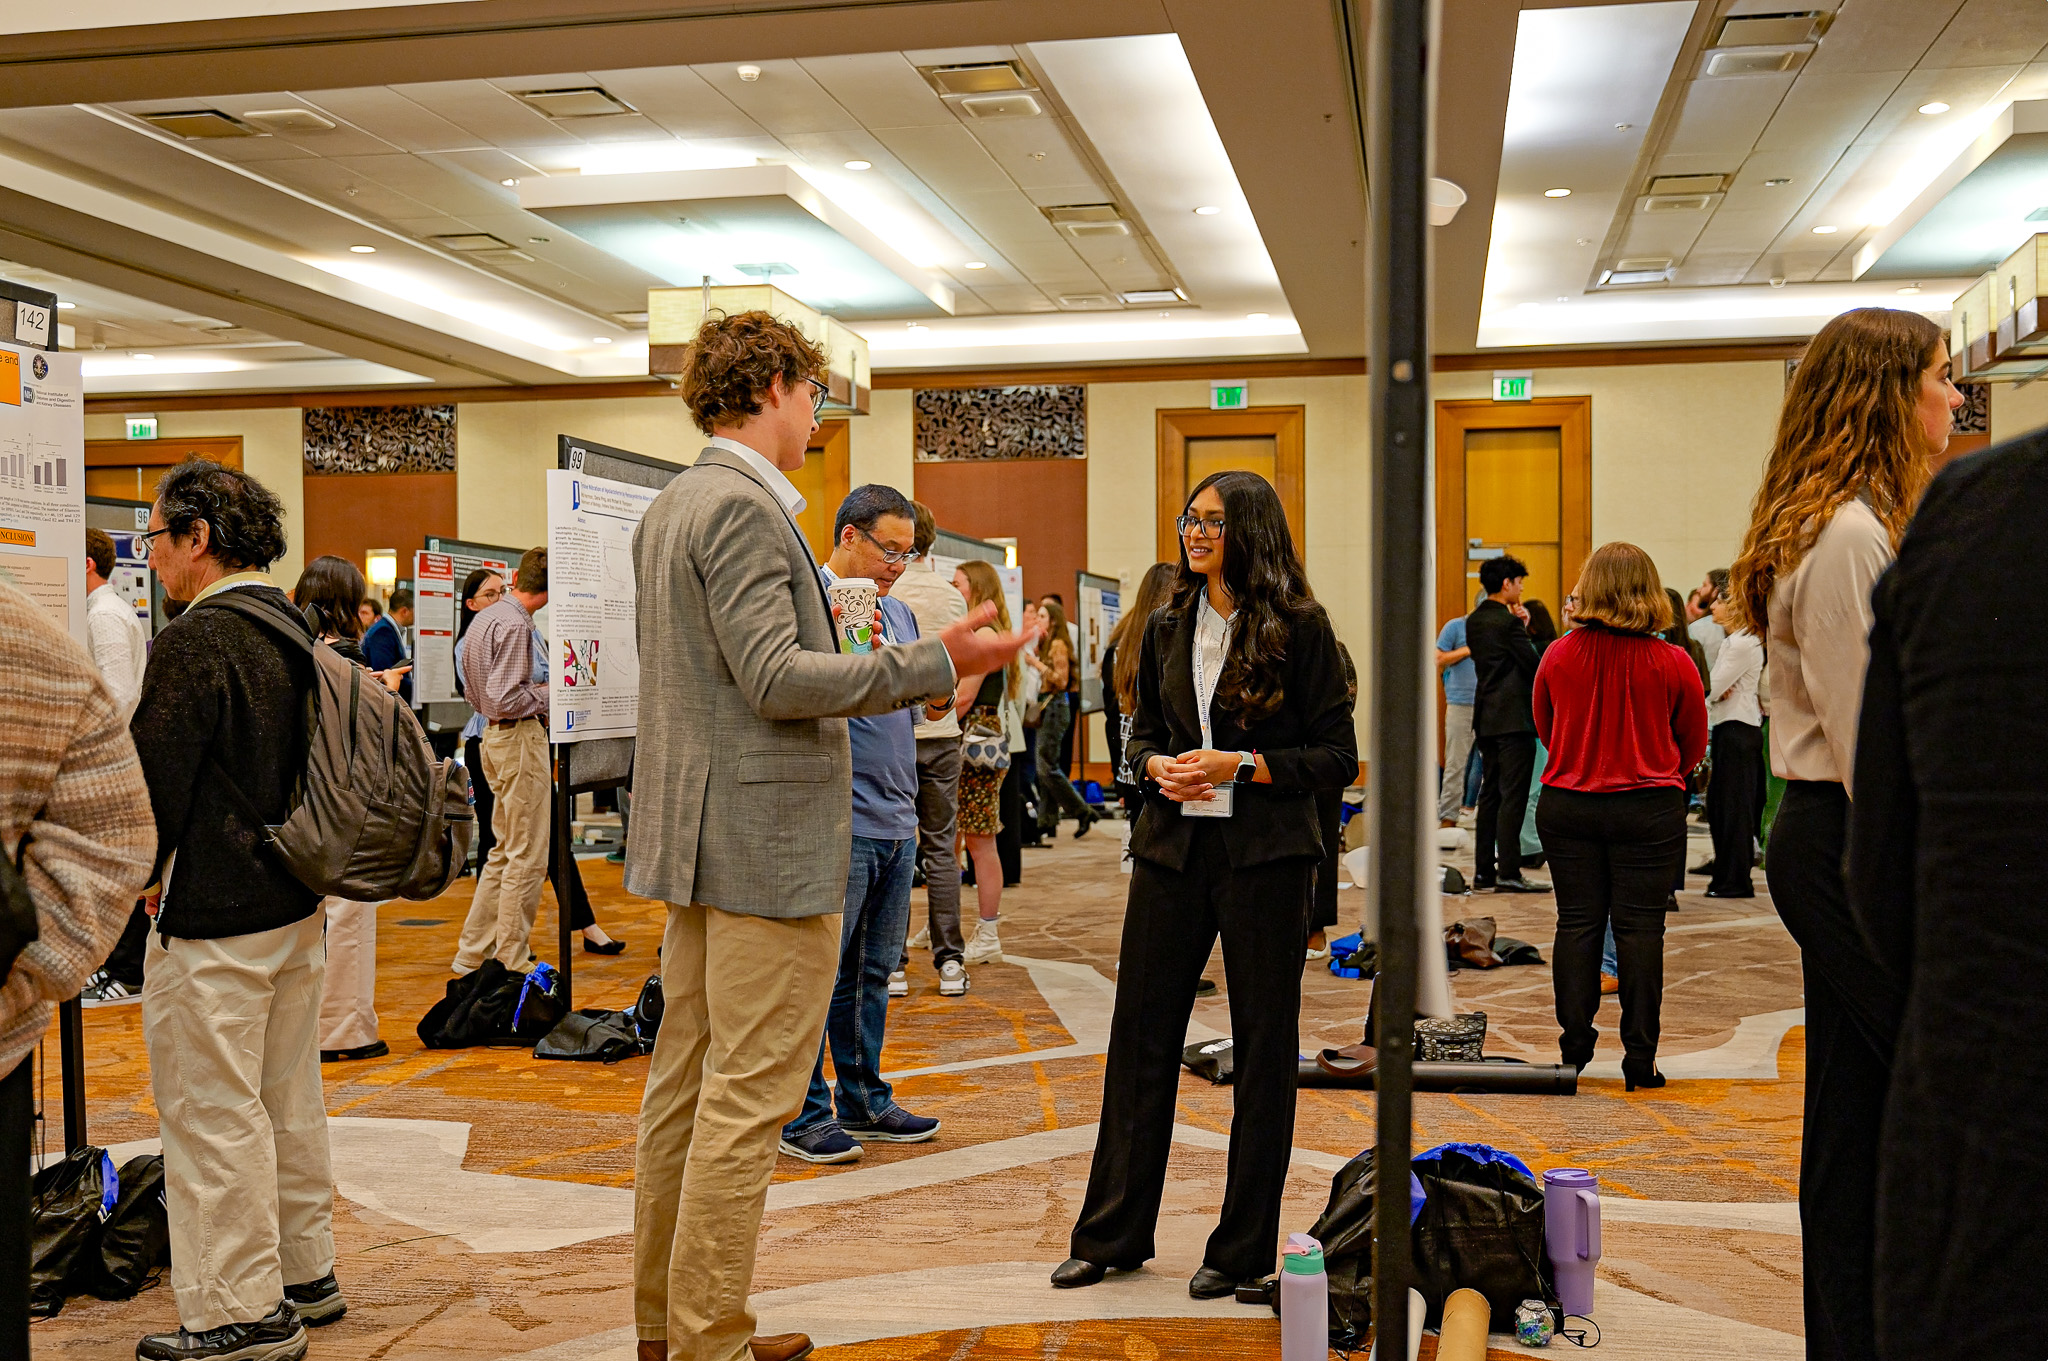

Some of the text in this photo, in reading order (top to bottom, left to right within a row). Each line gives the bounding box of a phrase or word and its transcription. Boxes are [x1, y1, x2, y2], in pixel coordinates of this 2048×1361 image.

[20, 307, 45, 331] 142
[5, 355, 19, 366] and
[1216, 387, 1242, 407] EXIT
[1500, 378, 1526, 397] EXIT
[571, 450, 583, 470] 99
[138, 510, 148, 524] 96
